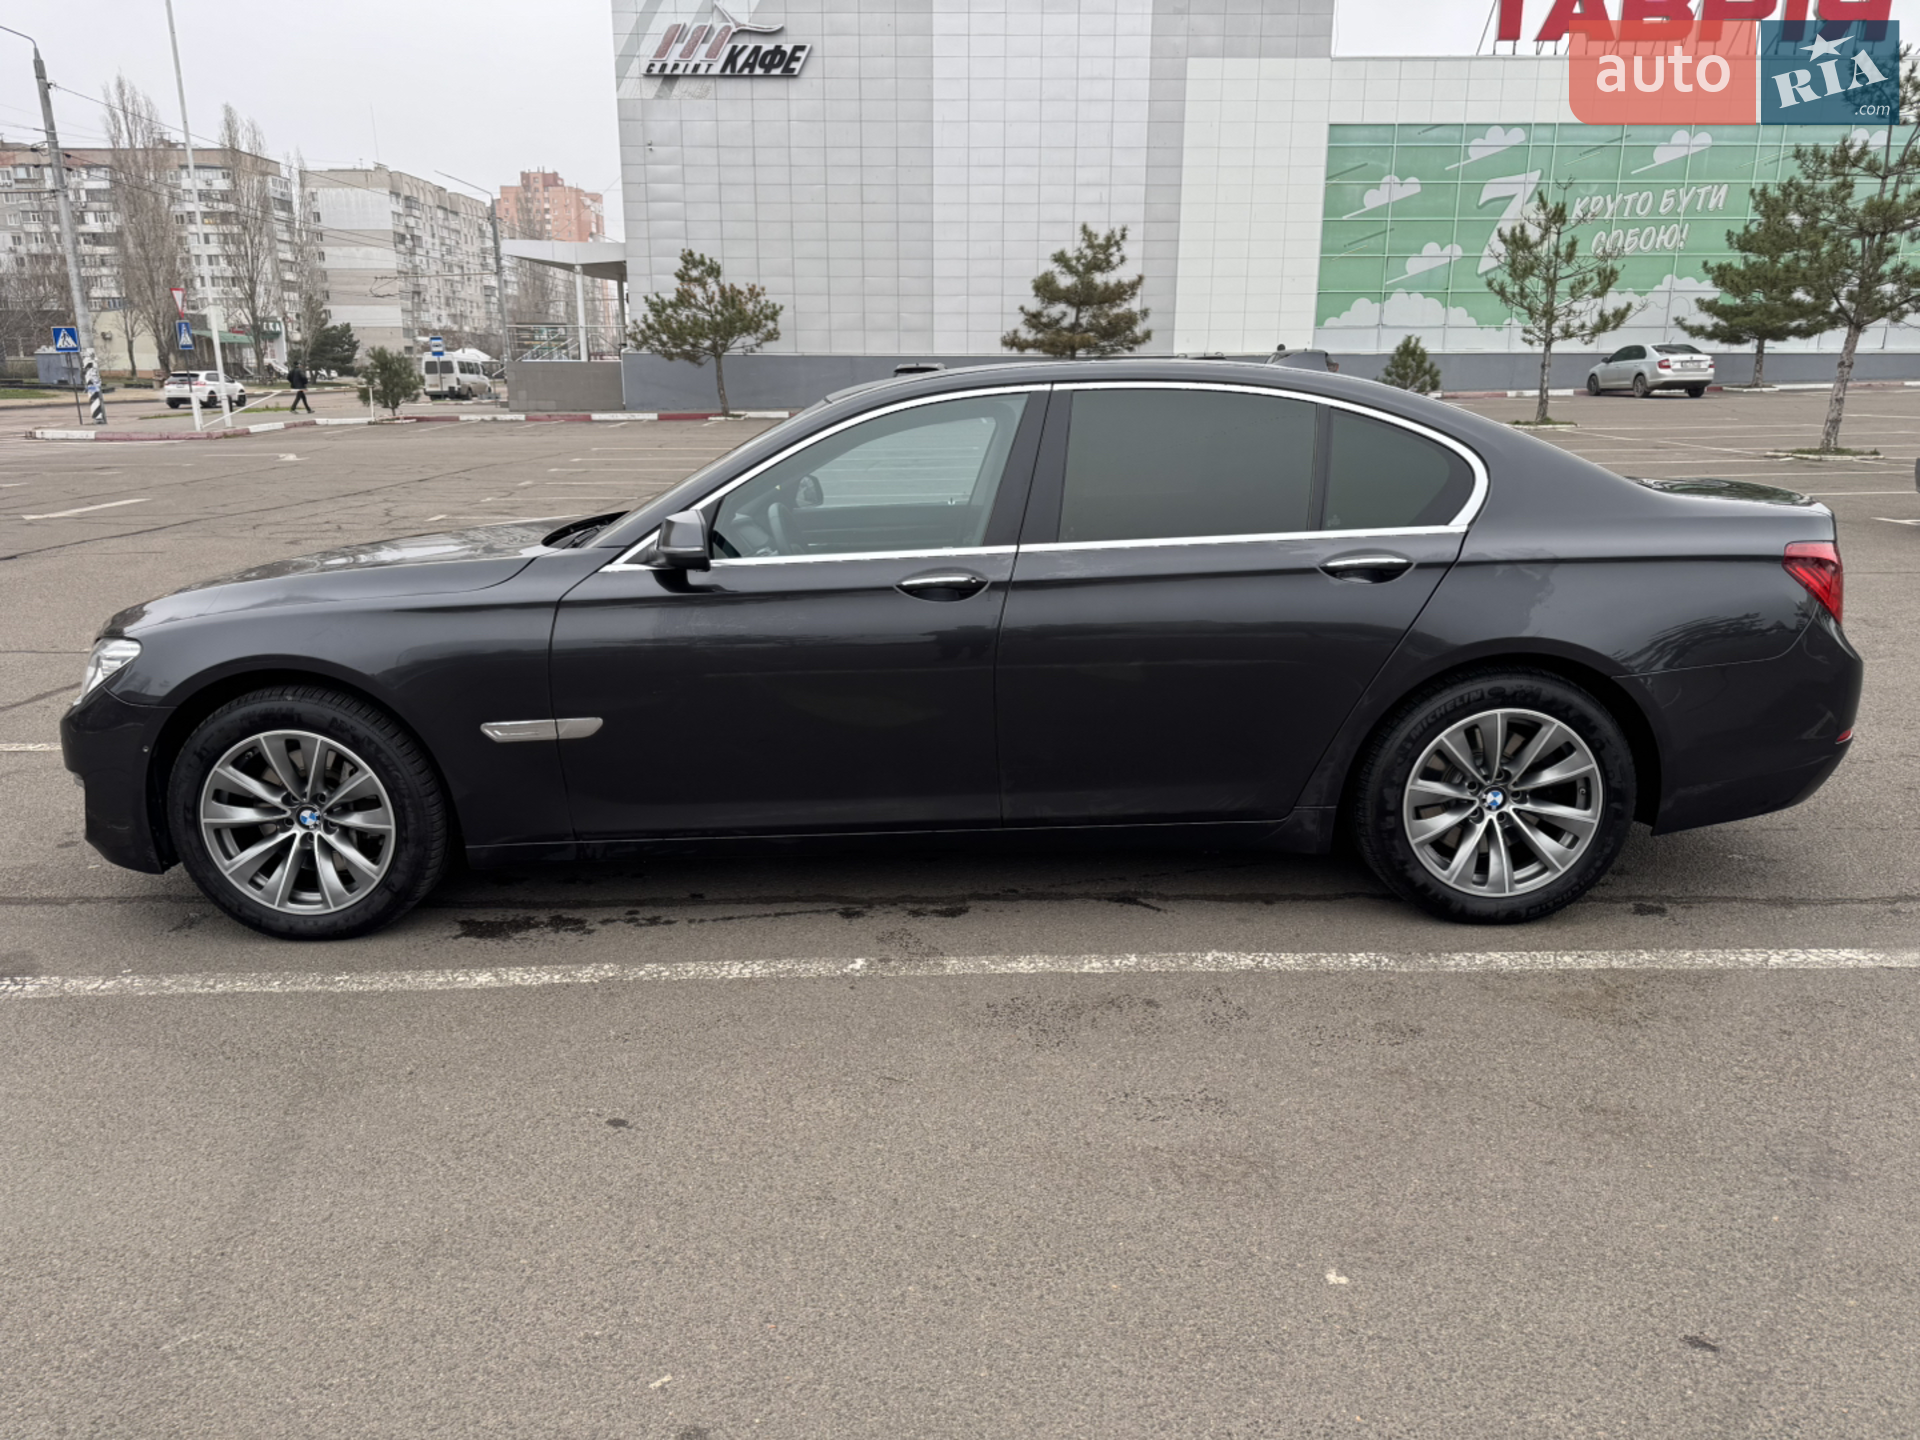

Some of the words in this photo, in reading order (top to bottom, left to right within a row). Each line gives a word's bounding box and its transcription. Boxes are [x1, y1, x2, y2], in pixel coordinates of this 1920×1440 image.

[646, 63, 714, 74] СПРІНТ
[720, 45, 807, 74] КАФЕ
[1570, 191, 1654, 225] КРУТО
[1659, 183, 1729, 216] БУТИ
[1591, 222, 1690, 257] СОБОЮ!
[1408, 688, 1484, 741] MICHELIN
